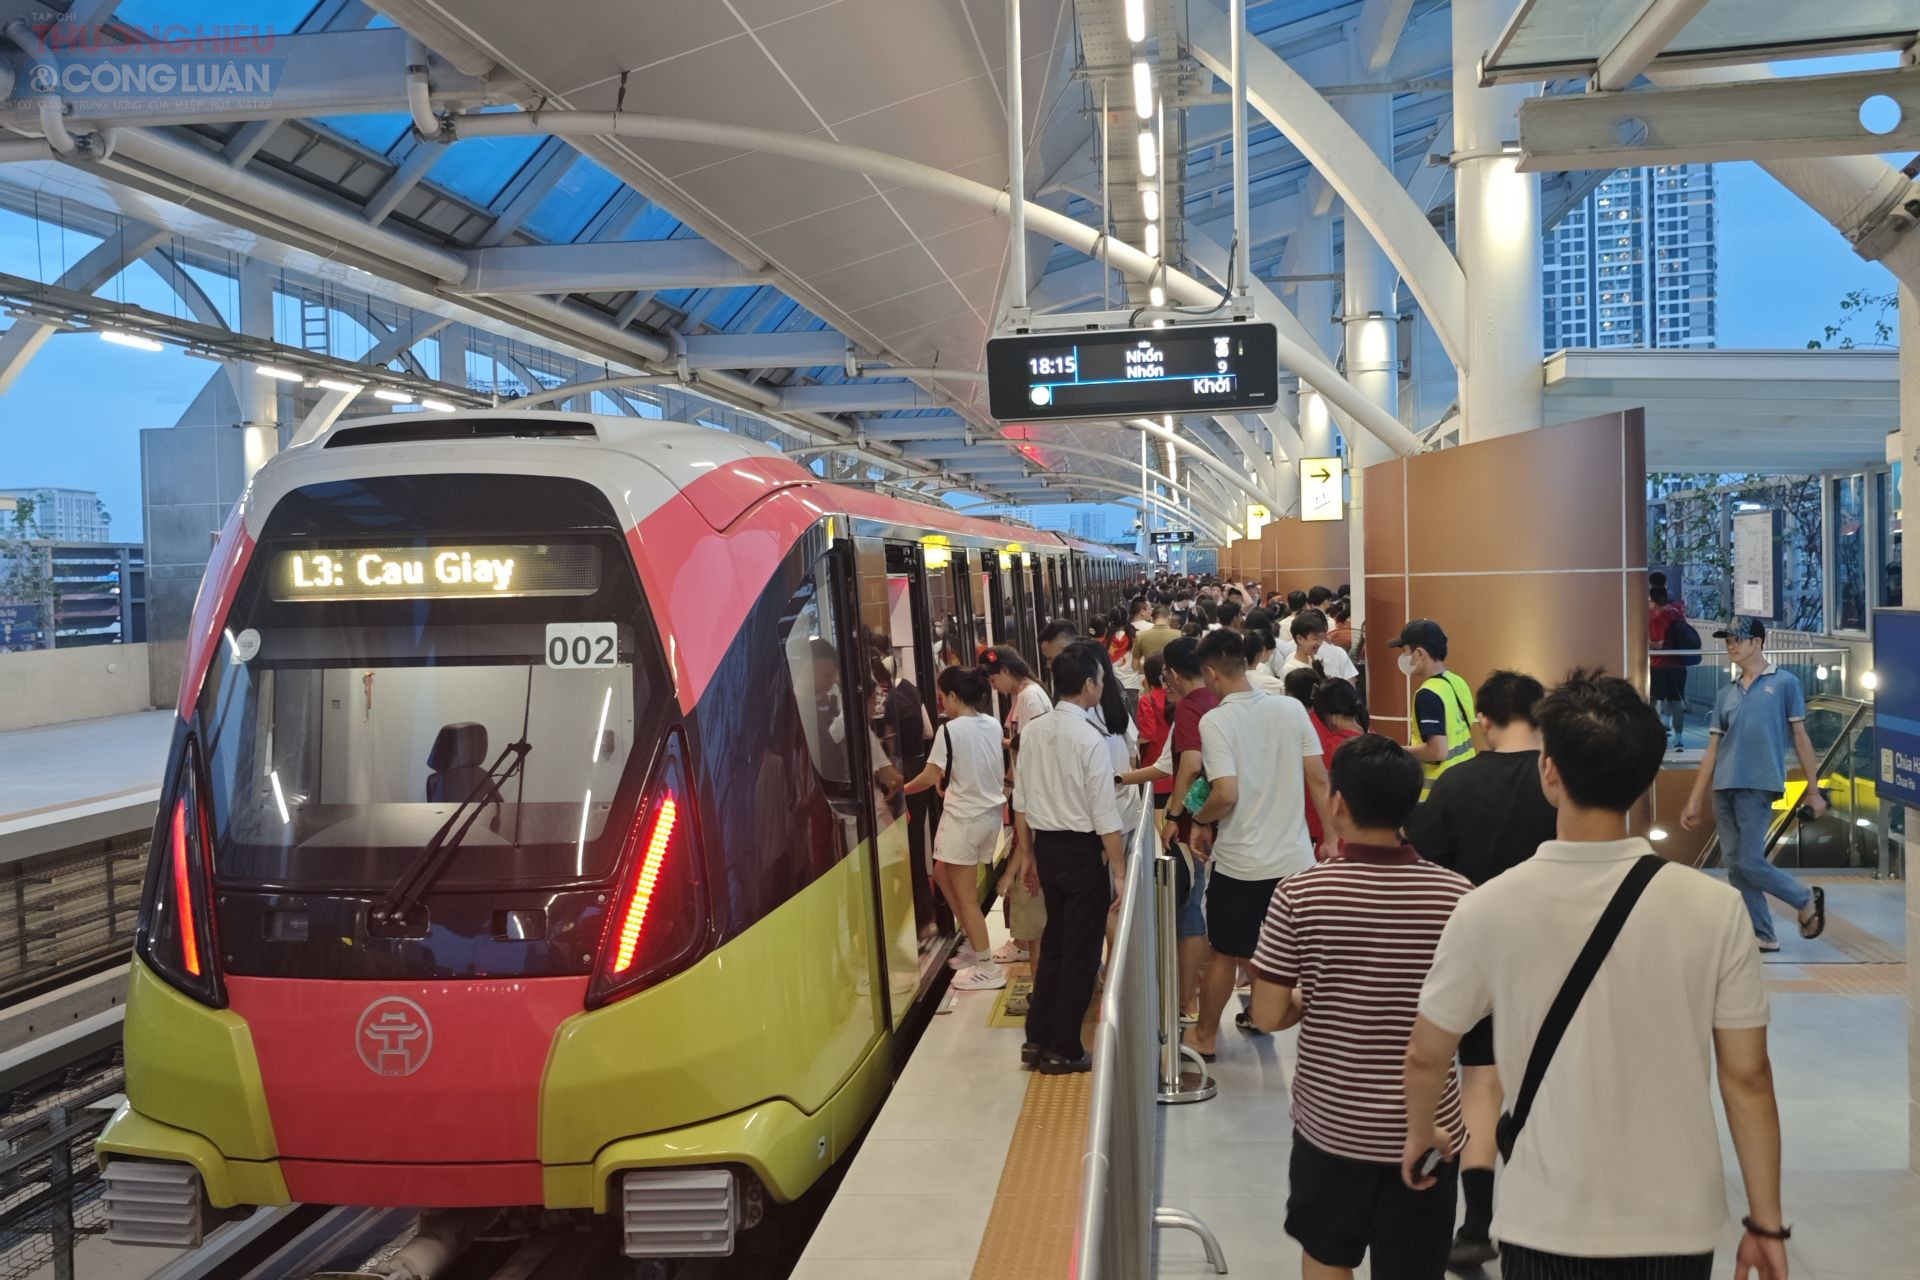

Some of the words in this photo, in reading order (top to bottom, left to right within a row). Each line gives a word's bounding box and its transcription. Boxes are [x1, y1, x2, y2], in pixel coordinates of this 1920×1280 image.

[1029, 356, 1076, 375] 18:15
[1217, 359, 1228, 374] 9
[293, 554, 344, 587] L3:
[357, 554, 424, 586] Cau
[435, 552, 514, 590] Giay
[549, 635, 615, 665] 002
